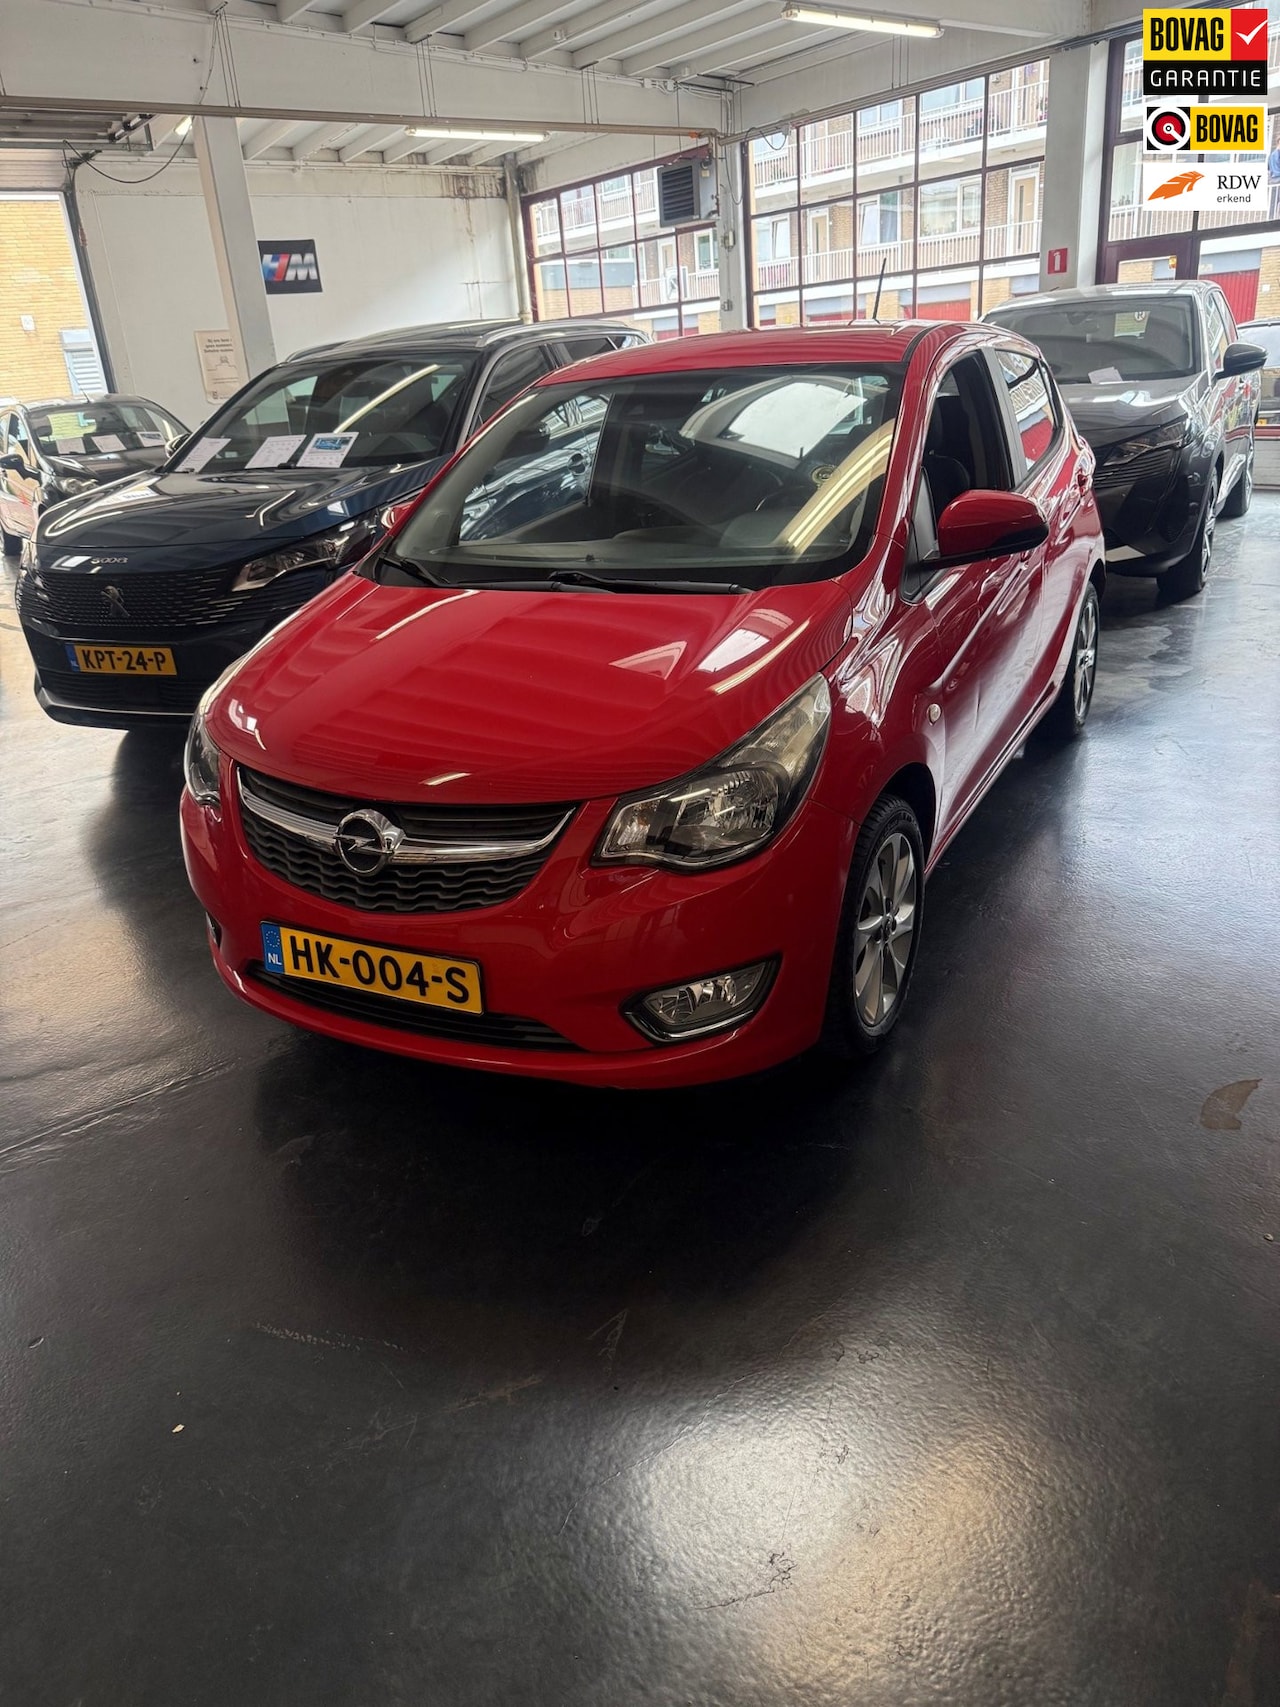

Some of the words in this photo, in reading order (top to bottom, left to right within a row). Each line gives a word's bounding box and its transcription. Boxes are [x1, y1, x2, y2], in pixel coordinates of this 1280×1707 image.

[81, 649, 166, 672] KPT-24-P
[267, 952, 283, 966] NL
[289, 935, 470, 1004] HK-004-S
